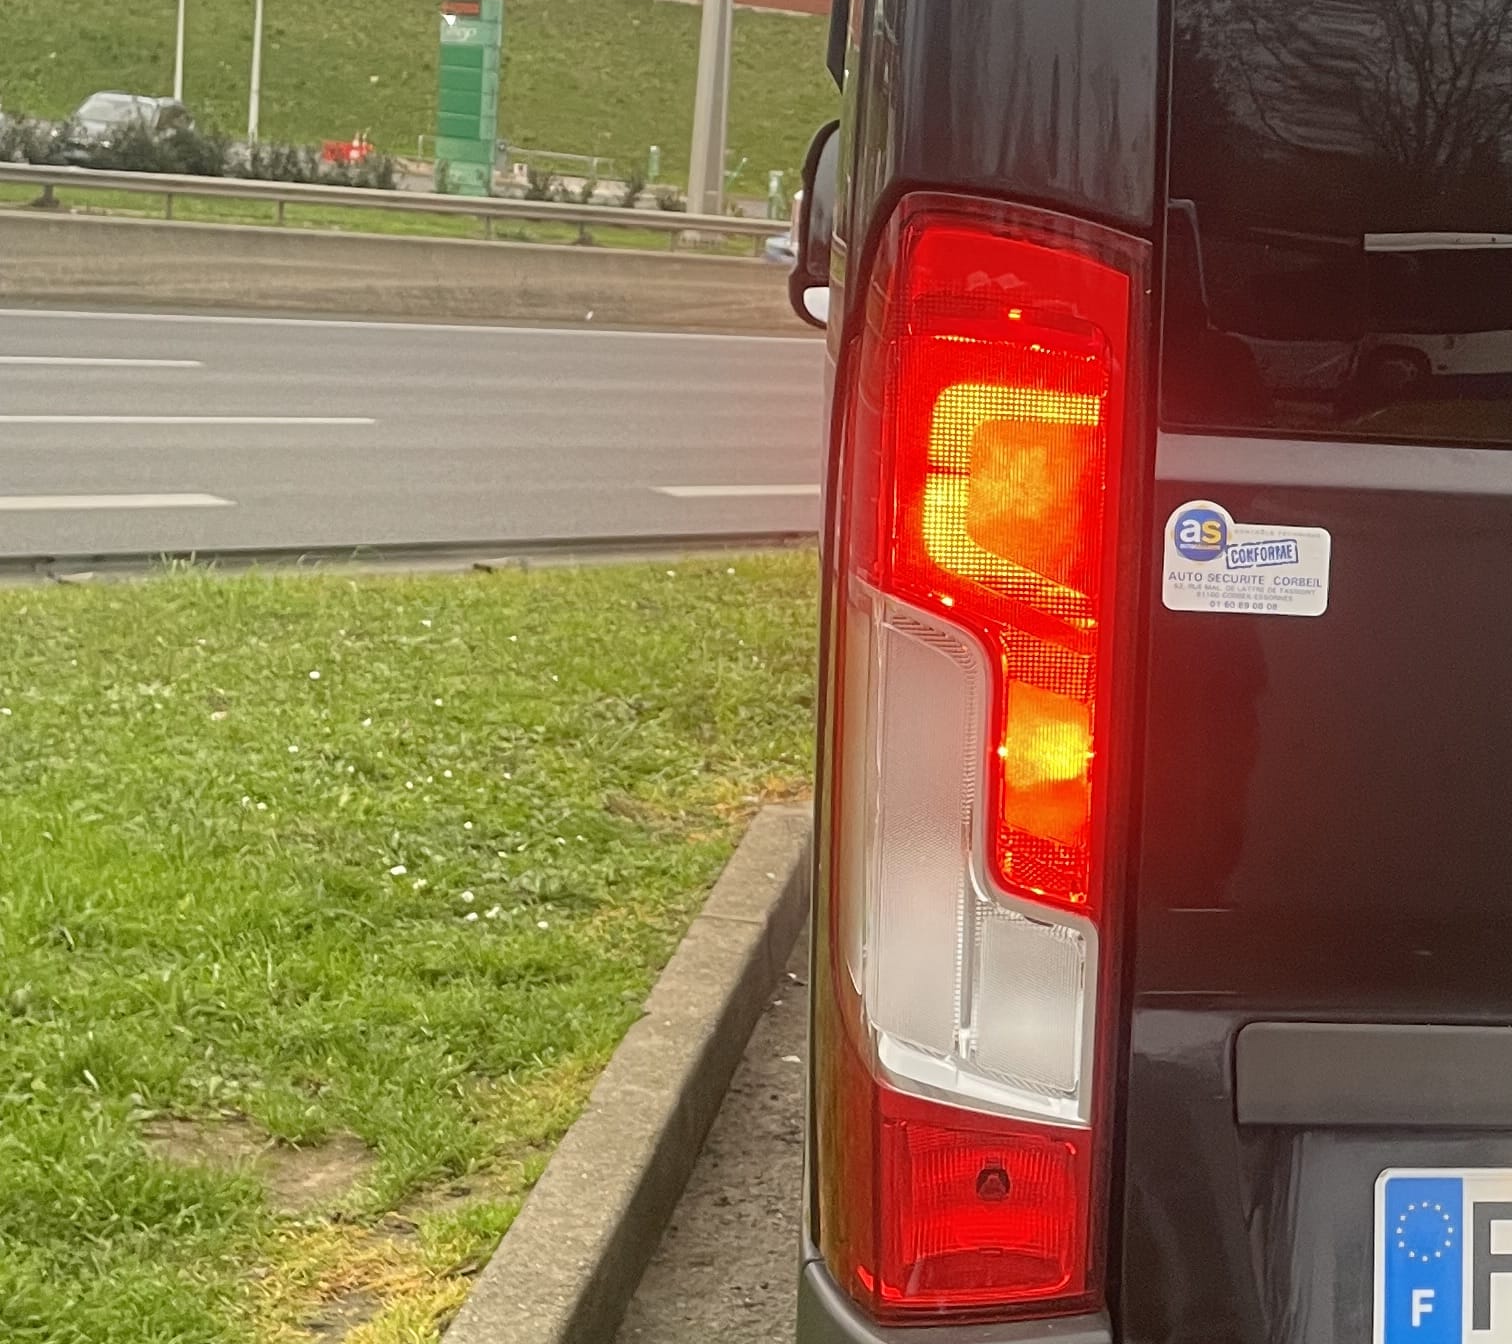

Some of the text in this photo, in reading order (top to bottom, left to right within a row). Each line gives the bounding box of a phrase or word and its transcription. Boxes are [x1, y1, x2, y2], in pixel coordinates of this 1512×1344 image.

[1179, 519, 1221, 544] as
[1231, 544, 1293, 564] CONFORME
[1168, 571, 1203, 582] AUTO
[1273, 575, 1322, 588] CORBEIL
[1411, 1289, 1434, 1326] F
